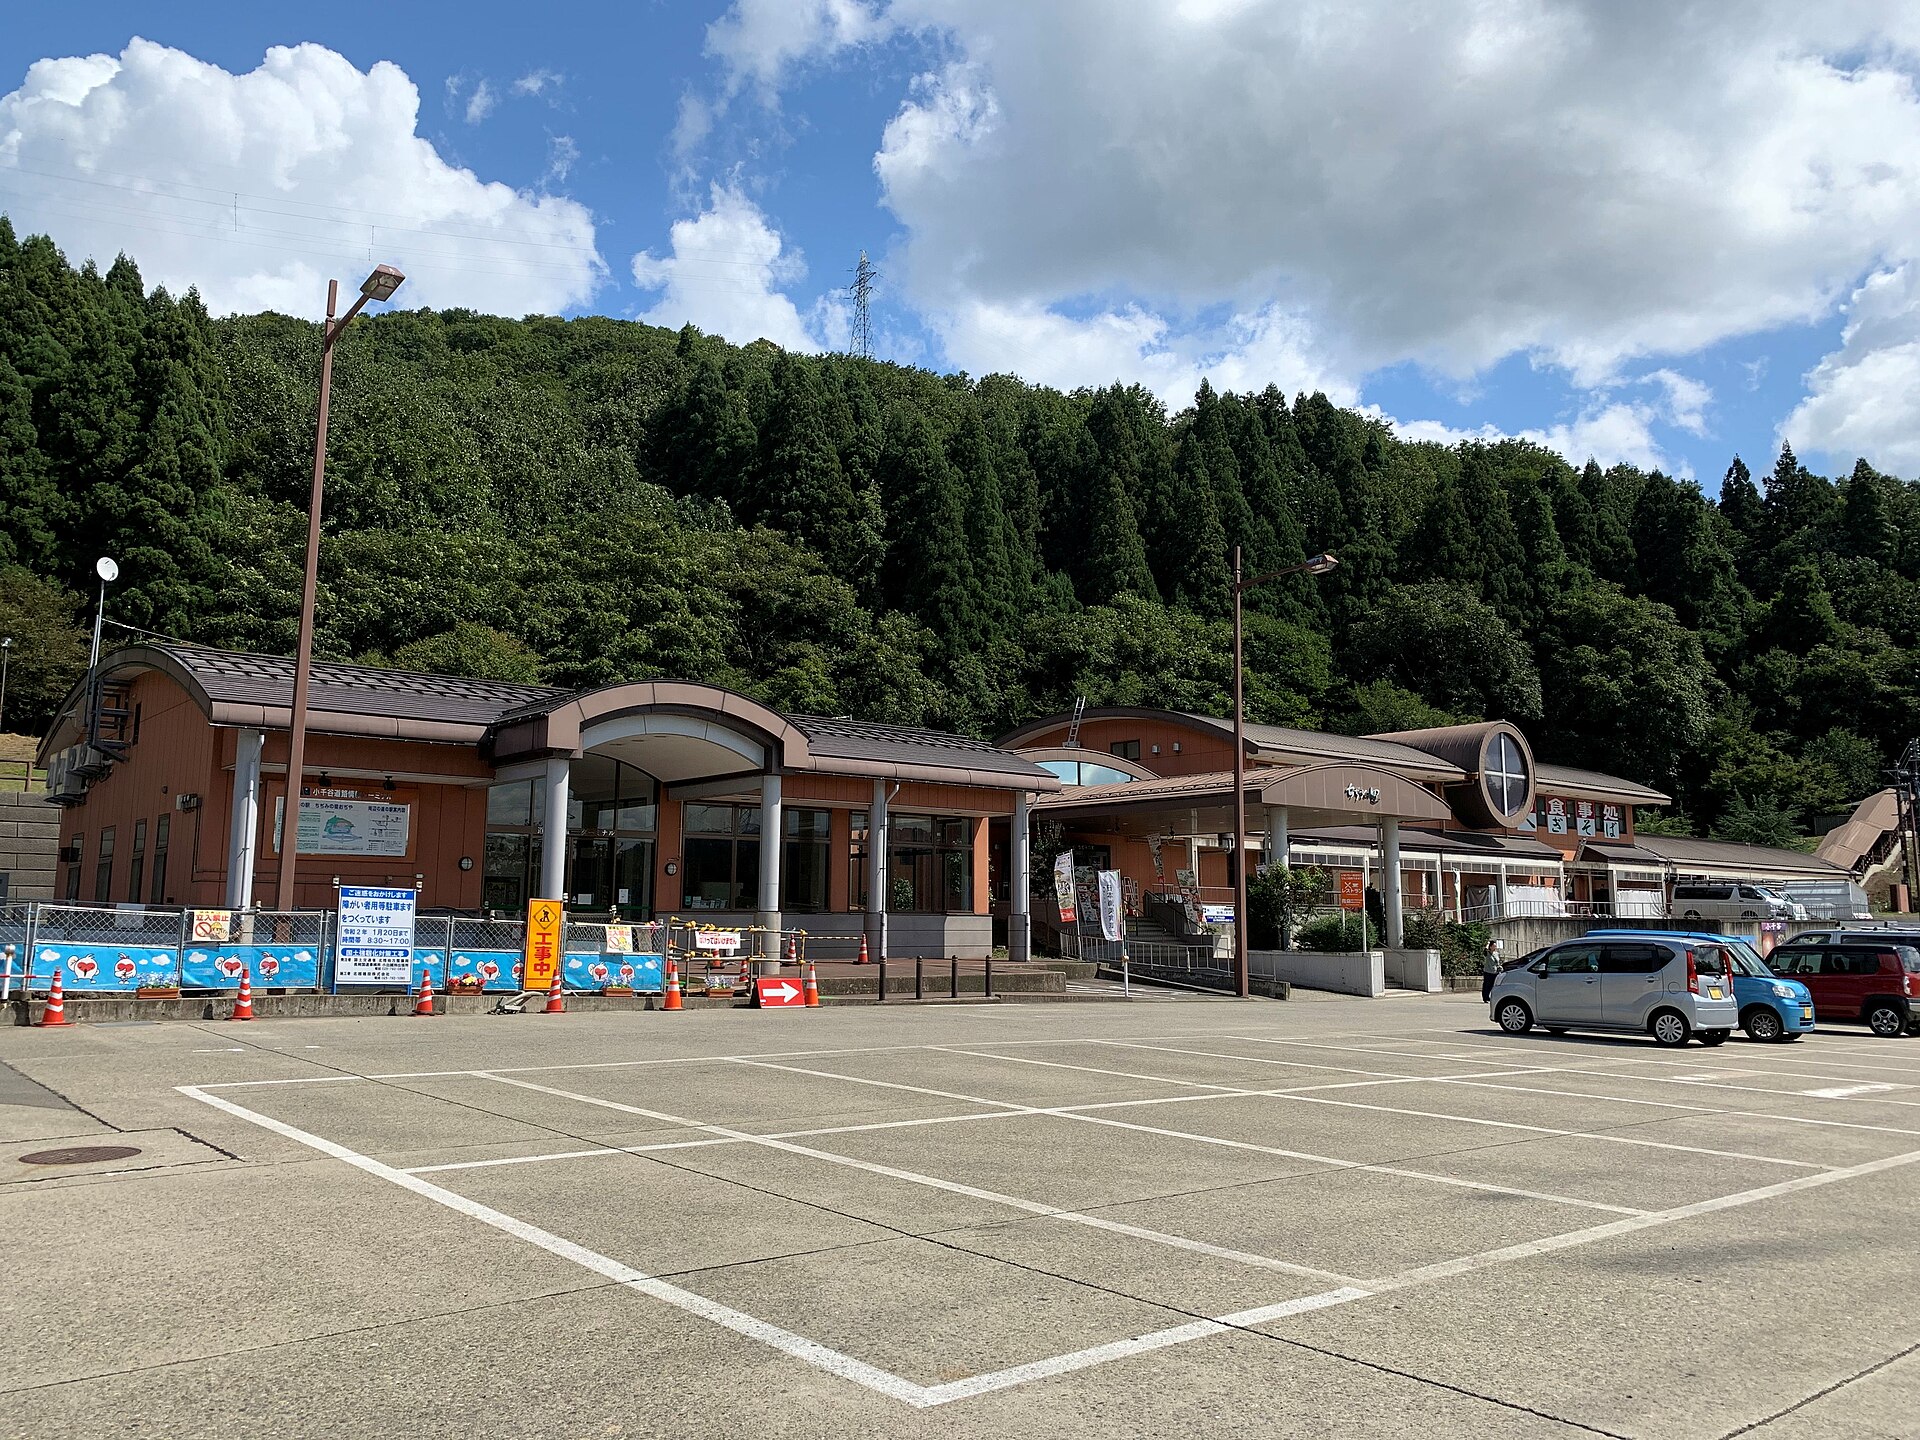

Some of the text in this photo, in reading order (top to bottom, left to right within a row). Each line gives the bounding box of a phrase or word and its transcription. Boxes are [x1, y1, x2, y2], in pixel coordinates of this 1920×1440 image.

[1548, 797, 1619, 821] 食事処
[348, 889, 408, 898] ご迷惑をおかけします
[341, 900, 413, 911] 障がい者用等駐車ます
[341, 914, 391, 924] をつくっています
[533, 932, 552, 976] 工事中
